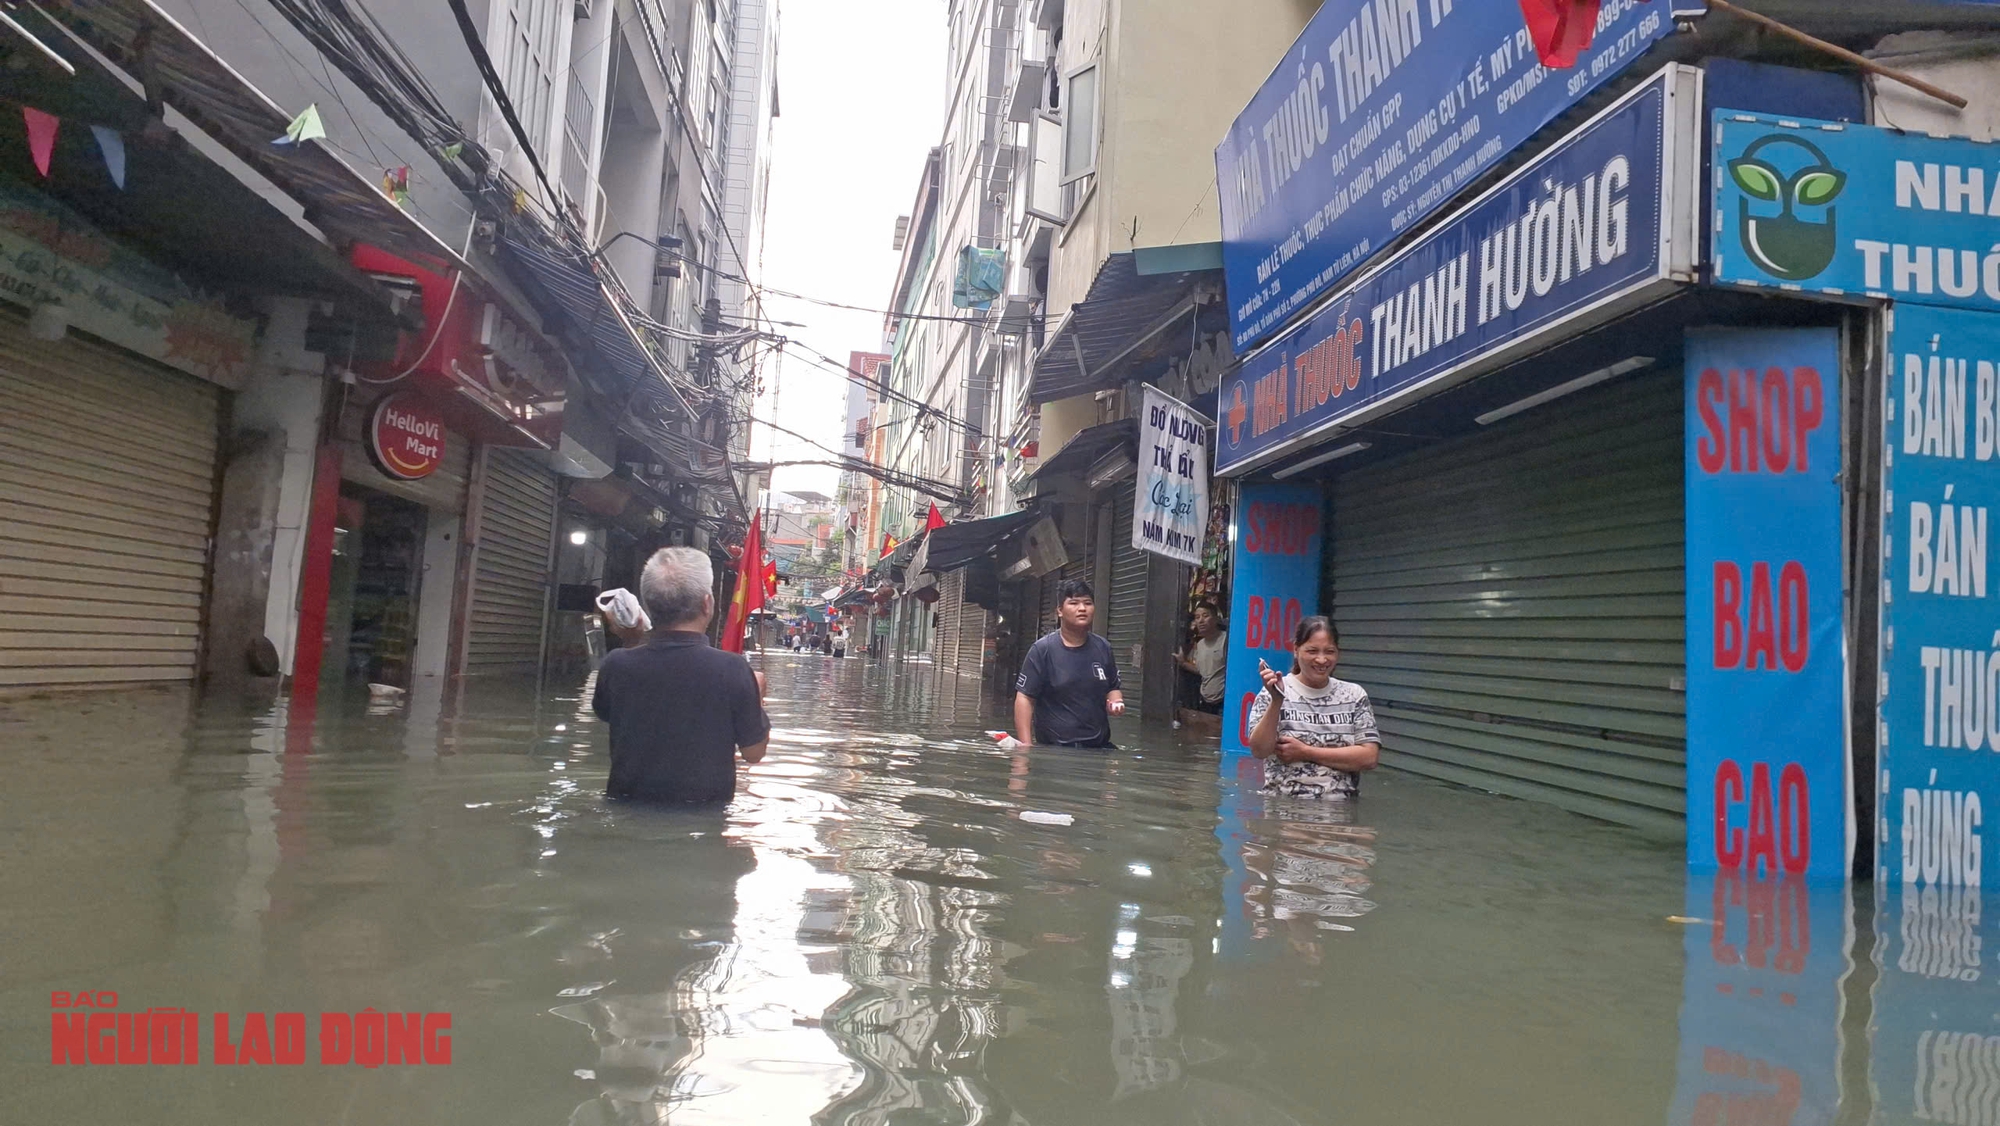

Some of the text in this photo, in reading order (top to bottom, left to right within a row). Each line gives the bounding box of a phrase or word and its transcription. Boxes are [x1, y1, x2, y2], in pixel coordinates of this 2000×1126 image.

[1263, 44, 1330, 198] THUỐC
[1329, 0, 1422, 124] THANH
[1350, 109, 1381, 160] CHUẨN
[1382, 92, 1402, 130] GPP
[1453, 154, 1476, 183] THANH
[1476, 134, 1502, 166] HƯỜNG
[1591, 45, 1616, 78] 0972
[1618, 27, 1637, 58] 277
[1639, 10, 1660, 40] 666
[1257, 256, 1271, 285] BÁN
[1271, 244, 1280, 273] LẺ
[1279, 227, 1305, 265] THUỐC,
[1304, 210, 1324, 243] THỰC
[1324, 185, 1350, 226] PHẨM
[1350, 165, 1374, 204] CHỨC
[1375, 139, 1407, 183] NĂNG,
[1407, 108, 1438, 155] DỤNG
[1439, 90, 1456, 126] CỤ
[1457, 81, 1466, 109] Y
[1467, 54, 1489, 100] TẾ,
[1491, 34, 1512, 82] MỸ
[1382, 184, 1399, 208] GPS:
[1252, 351, 1288, 438] NHÀ
[1294, 299, 1362, 418] THUỐC
[1370, 250, 1470, 379] THANH
[1477, 154, 1630, 326] HƯỜNG
[385, 408, 440, 441] HelloVi
[406, 435, 439, 459] Mart
[1697, 366, 1824, 474] SHOP
[1903, 334, 1967, 459] BÁN
[1183, 535, 1196, 553] 7K
[1245, 500, 1318, 554] SHOP
[1909, 484, 1988, 597] BÁN
[1713, 560, 1810, 672] BAO
[1713, 758, 1811, 875] CAO
[1902, 768, 1982, 886] ĐÚNG
